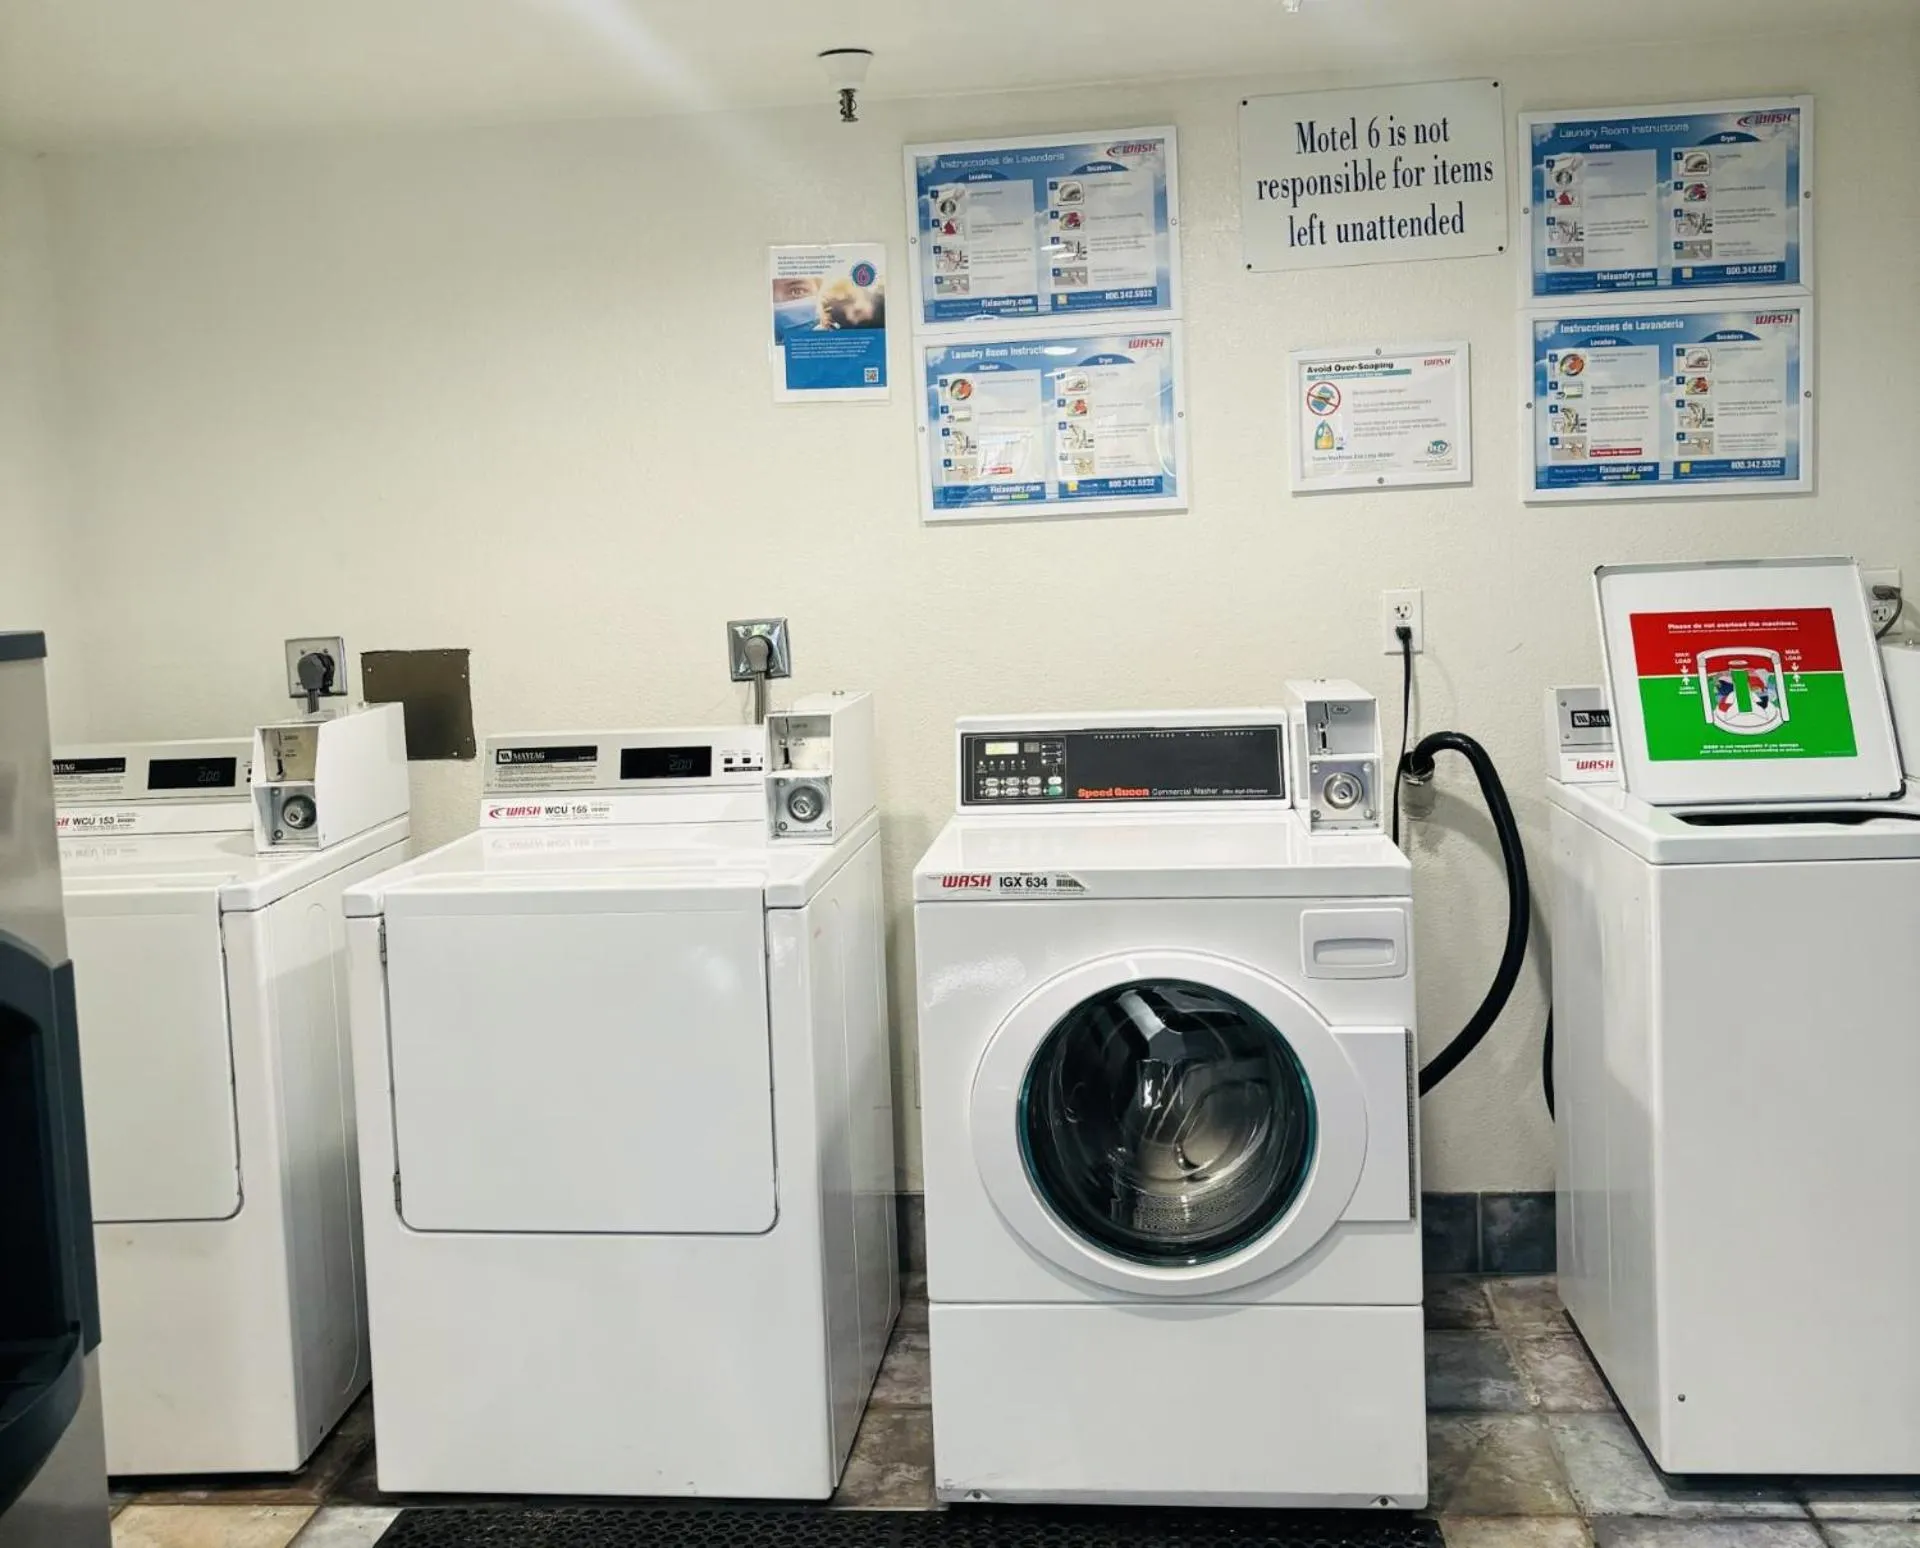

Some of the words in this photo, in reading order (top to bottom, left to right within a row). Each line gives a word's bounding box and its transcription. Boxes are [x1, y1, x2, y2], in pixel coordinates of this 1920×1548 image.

[1295, 117, 1358, 155] Motel
[1367, 115, 1381, 149] 6
[1387, 114, 1407, 147] is
[1413, 116, 1450, 145] not
[1560, 127, 1598, 139] Laundry
[1600, 126, 1629, 136] Room
[1631, 123, 1690, 134] Instructions
[1257, 158, 1387, 208] responsible
[1392, 155, 1426, 189] for
[1432, 154, 1494, 186] items
[1288, 212, 1327, 248] left
[1336, 200, 1465, 244] unattended
[1622, 320, 1634, 331] de
[1755, 314, 1793, 325] WASH
[1128, 338, 1164, 349] WASH
[951, 348, 984, 361] Laundry
[985, 347, 1009, 357] Room
[1306, 364, 1332, 374] Avoid
[1334, 361, 1395, 373] Over-Soaping
[1576, 759, 1614, 770] WASH
[1078, 789, 1113, 799] Speed
[1114, 788, 1150, 797] Queen
[506, 806, 541, 816] WASH
[544, 805, 568, 815] WCU
[72, 817, 96, 826] WCU
[942, 874, 992, 888] WASH
[1000, 876, 1022, 888] IGX
[1025, 876, 1048, 888] 634
